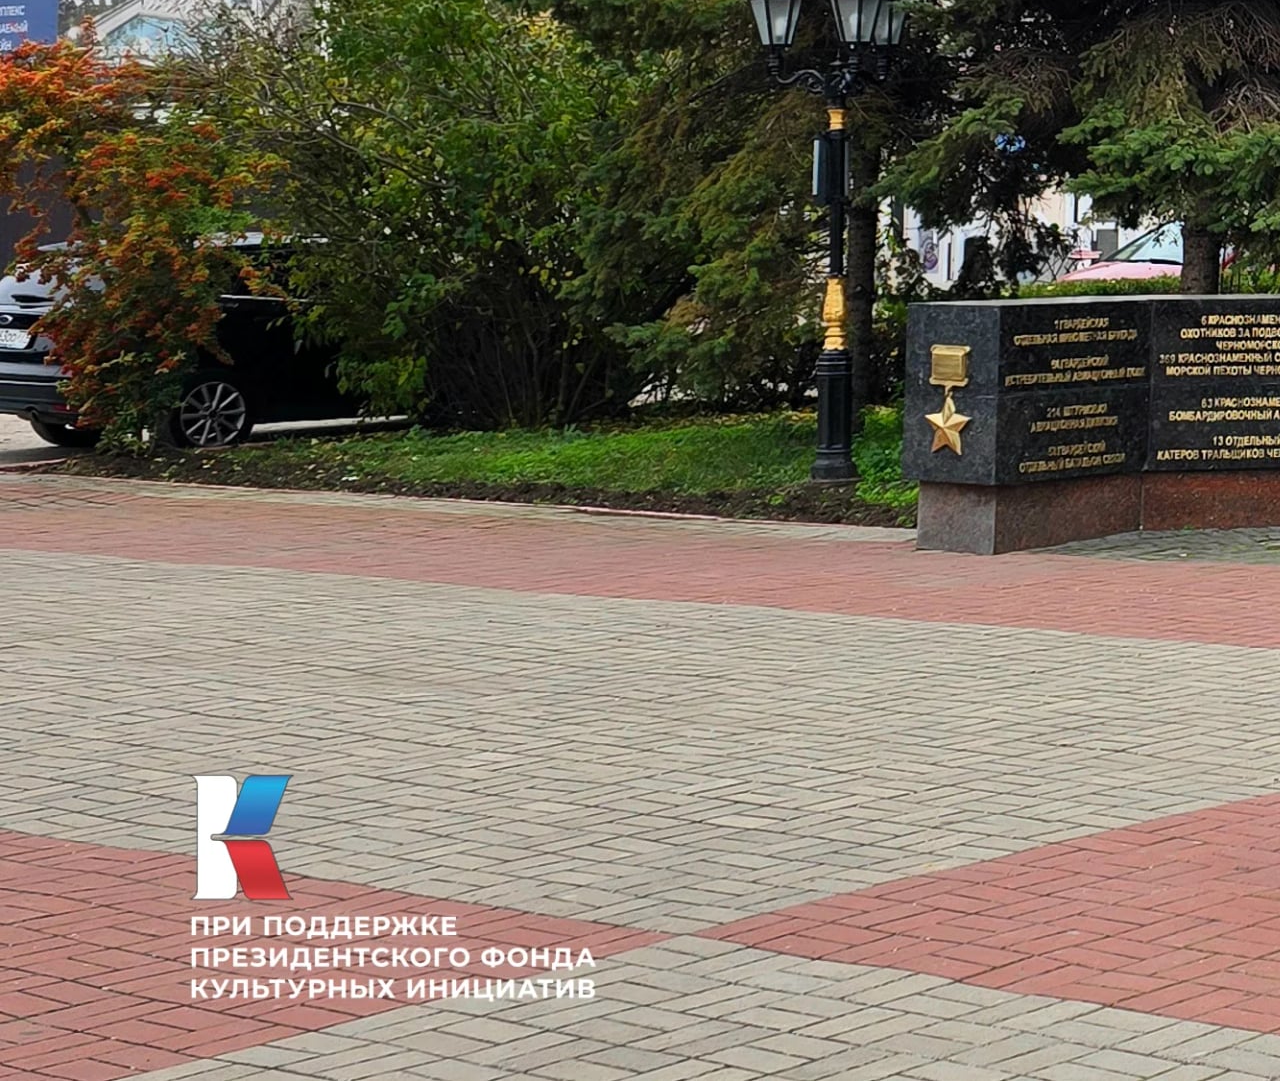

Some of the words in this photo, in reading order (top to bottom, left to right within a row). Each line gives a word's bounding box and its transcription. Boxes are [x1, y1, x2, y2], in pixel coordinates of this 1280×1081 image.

[1201, 316, 1206, 325] 6
[1180, 328, 1236, 339] ОХОТНИКОВ
[1238, 328, 1250, 337] ЗА
[1178, 351, 1272, 363] КРАСНОЗНАМЕННЫЙ
[1166, 364, 1211, 376] МОРСКОЙ
[1213, 366, 1252, 375] ПЕХОТЫ
[1169, 408, 1272, 422] БОМБАРДИРОВОЧНЫЙ
[1157, 449, 1199, 460] КАТЕРОВ
[1201, 449, 1264, 460] ТРАЛЬЩИКОВ
